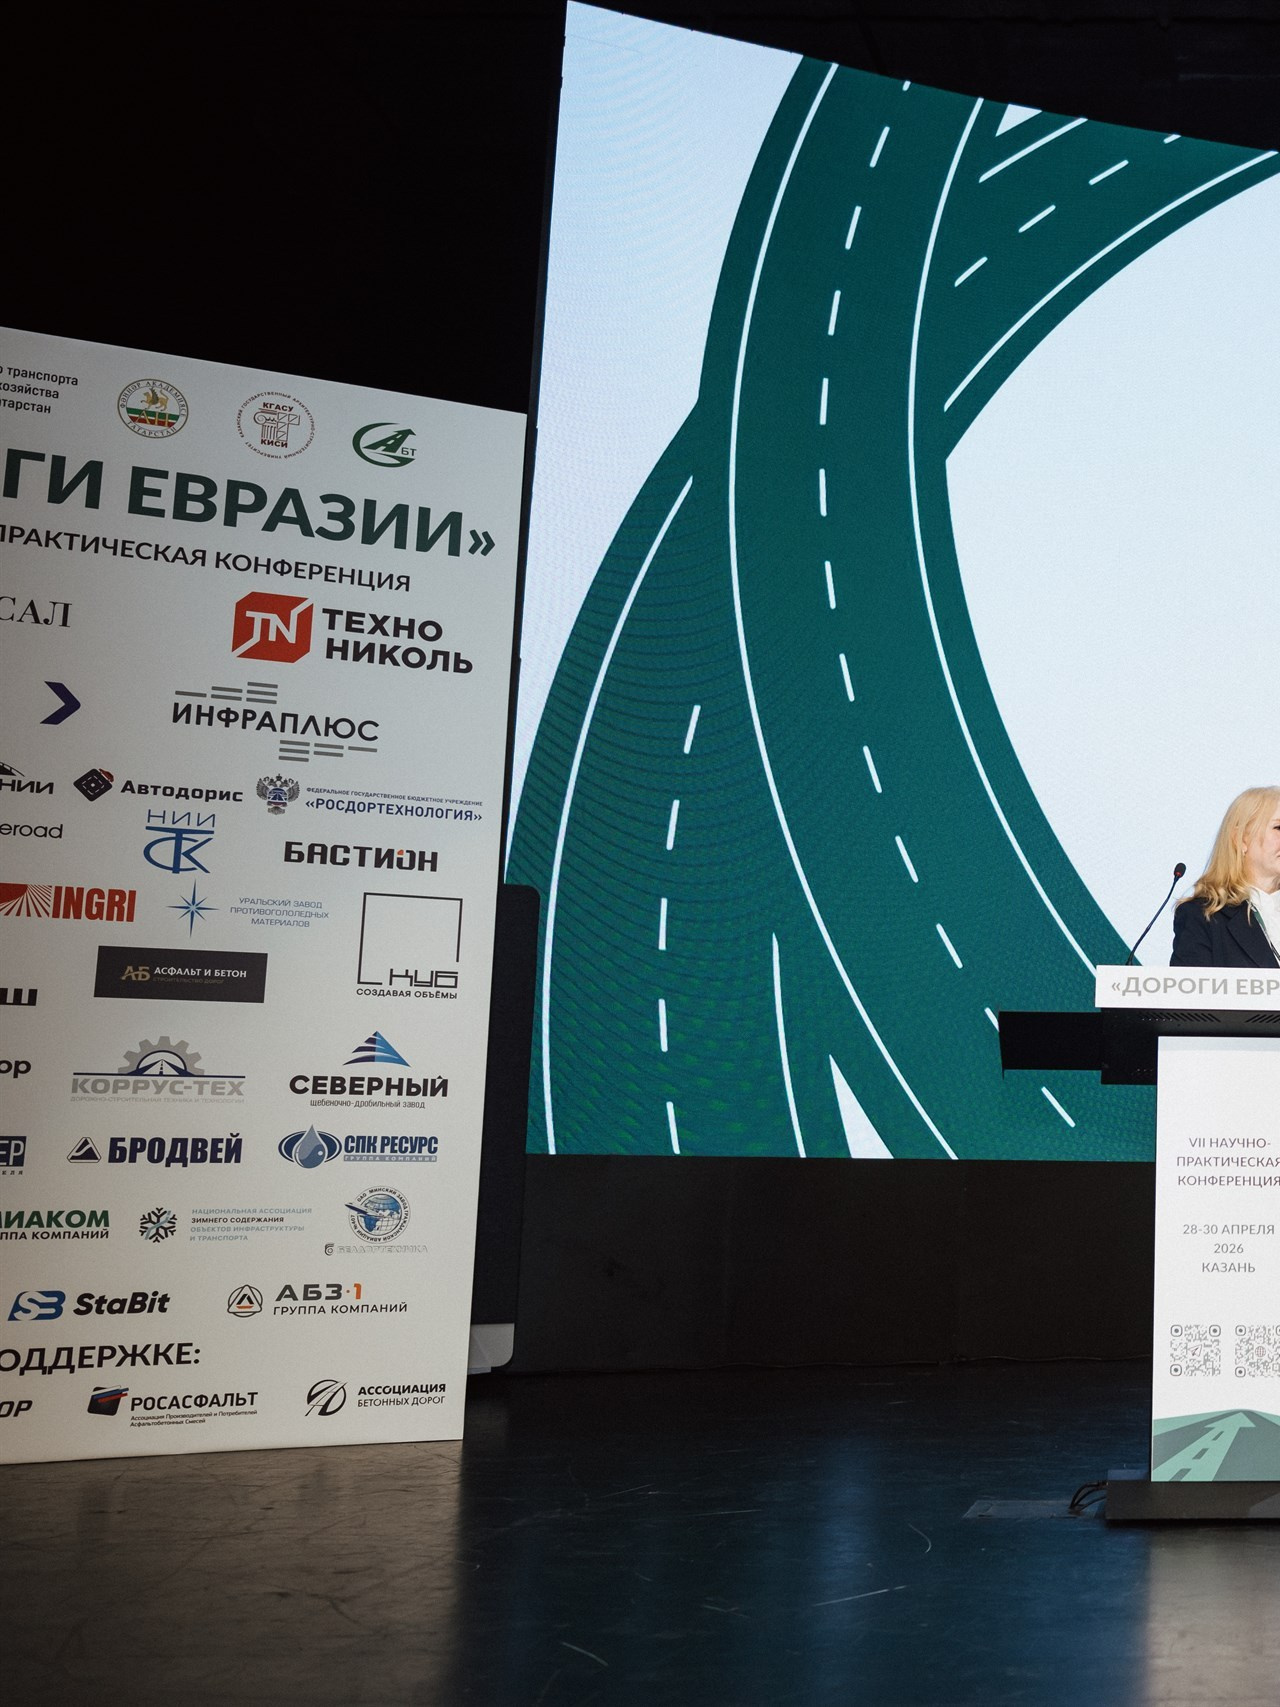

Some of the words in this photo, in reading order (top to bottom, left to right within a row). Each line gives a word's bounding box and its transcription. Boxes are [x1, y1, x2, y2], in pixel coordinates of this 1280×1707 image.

[7, 366, 78, 386] транспорта
[0, 398, 51, 414] тарстан
[262, 401, 294, 413] КГАСУ
[260, 438, 289, 449] КИСИ
[3, 448, 103, 510] ГИ
[128, 465, 496, 557] ЕВРАЗИИ»
[215, 551, 411, 592] КОНФЕРЕНЦИЯ
[322, 608, 443, 642] ТЕХНО
[325, 637, 474, 674] НИКОЛЬ
[172, 702, 380, 742] ИНФРАПЛЮС
[120, 779, 244, 803] Автодорис
[306, 787, 350, 795] ФЕДЕРАЛЬНОЕ
[351, 791, 406, 800] ГОСУДАРСТВЕННОЕ
[407, 795, 444, 803] БЮДЖЕТНОЕ
[305, 798, 483, 821] «РОСДОРТЕХНОЛОГИЯ»
[147, 809, 216, 828] НИИ
[283, 841, 439, 872] БАСТИОН
[51, 885, 137, 922] INGRI
[239, 897, 291, 907] УРАЛЬСКИЙ
[293, 900, 323, 909] ЗАВОД
[230, 906, 330, 918] ПРОТИВОГОЛОЛЕДНЫХ
[251, 918, 310, 928] МАТЕРИАЛОВ
[154, 966, 201, 977] АСФАЛЬТ
[204, 968, 212, 977] И
[214, 968, 248, 978] БЕТОН
[356, 988, 412, 998] СОЗДАВАЯ
[414, 989, 458, 1000] ОБЪЁМЫ
[1111, 976, 1228, 997] «ДОРОГИ
[71, 1078, 245, 1096] КОРРУС-ТЕХ
[289, 1074, 449, 1098] СЕВЕРНЫЙ
[310, 1099, 401, 1108] щебеночно-дробильный
[402, 1101, 426, 1109] завод
[108, 1132, 243, 1167] БРОДВЕЙ
[344, 1135, 379, 1154] СПК
[379, 1135, 439, 1154] РЕСУРС
[1188, 1138, 1206, 1148] VII
[1209, 1138, 1272, 1148] НАУЧНО-
[32, 1228, 109, 1240] КОМПАНИЙ
[1183, 1224, 1218, 1235] 28-30
[1221, 1224, 1275, 1235] АПРЕЛЯ
[1213, 1243, 1244, 1254] 2026
[1201, 1262, 1256, 1273] КАЗАНЬ
[73, 1290, 171, 1316] StaBit
[273, 1305, 328, 1316] ГРУППА
[331, 1301, 408, 1315] КОМПАНИЙ
[358, 1383, 446, 1396] АССОЦИАЦИЯ
[130, 1391, 258, 1411] РОСАСФАЛЬТ
[357, 1396, 410, 1408] БЕТОННЫХ
[411, 1395, 446, 1406] ДОРОГ
[165, 1411, 213, 1420] Производителей
[219, 1409, 258, 1417] Потребителей
